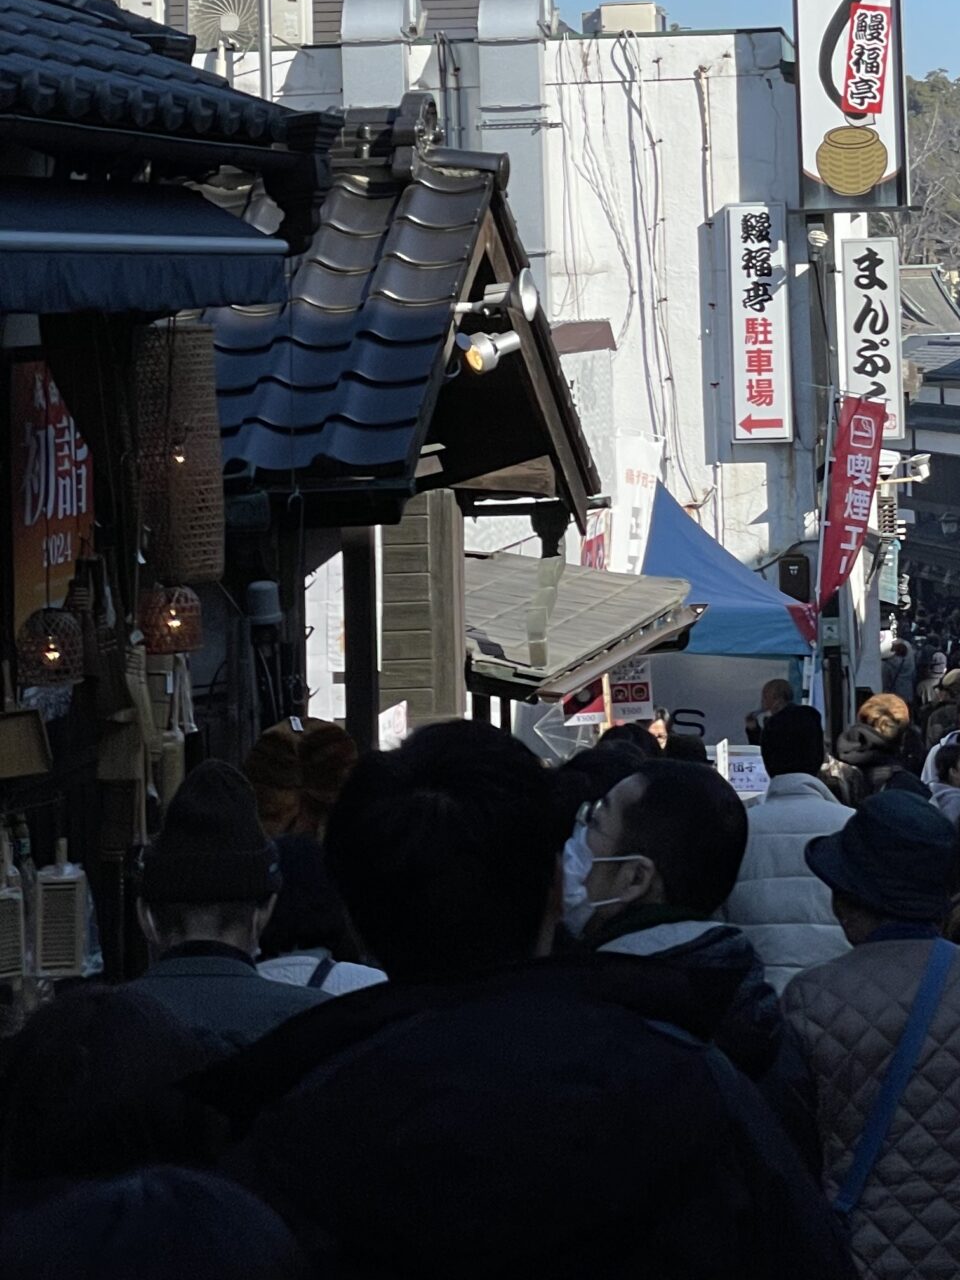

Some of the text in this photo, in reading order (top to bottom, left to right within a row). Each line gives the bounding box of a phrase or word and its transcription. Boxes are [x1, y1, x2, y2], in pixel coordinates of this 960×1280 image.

[848, 11, 886, 108] 鰻福亭
[741, 211, 774, 313] 鰻福亭
[744, 317, 775, 407] 駐車場
[43, 531, 72, 568] 2024
[731, 761, 757, 773] 団子
